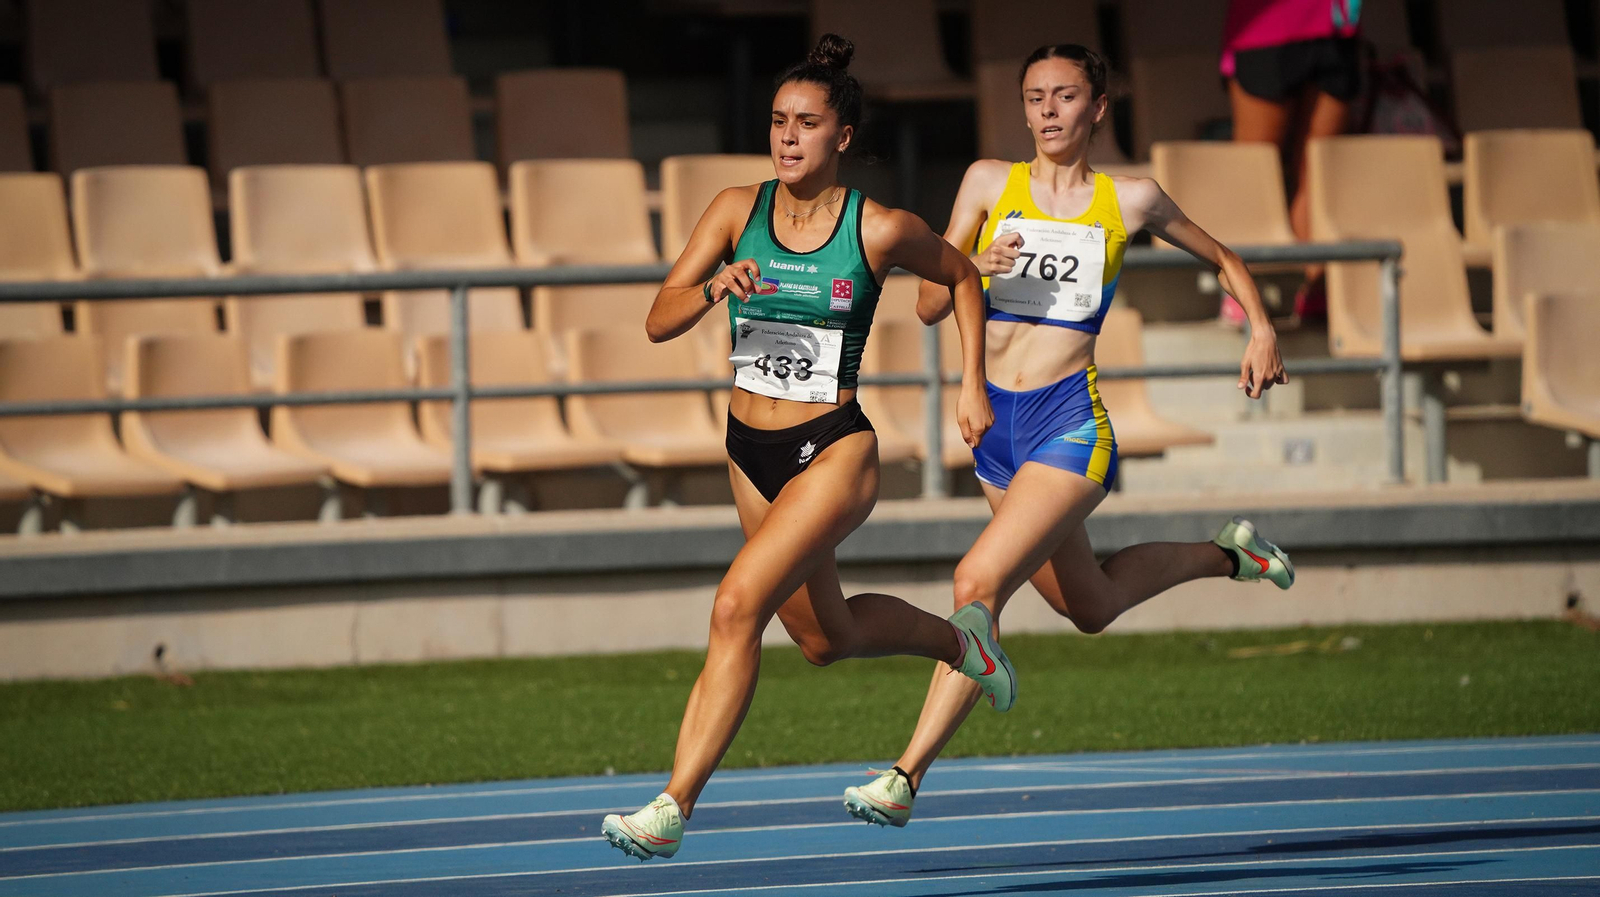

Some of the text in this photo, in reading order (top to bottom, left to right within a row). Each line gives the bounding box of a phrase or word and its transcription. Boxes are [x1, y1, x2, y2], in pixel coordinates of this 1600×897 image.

[769, 259, 805, 272] luanvi
[1019, 251, 1079, 283] 762
[761, 329, 784, 337] Federación
[754, 354, 814, 382] 433
